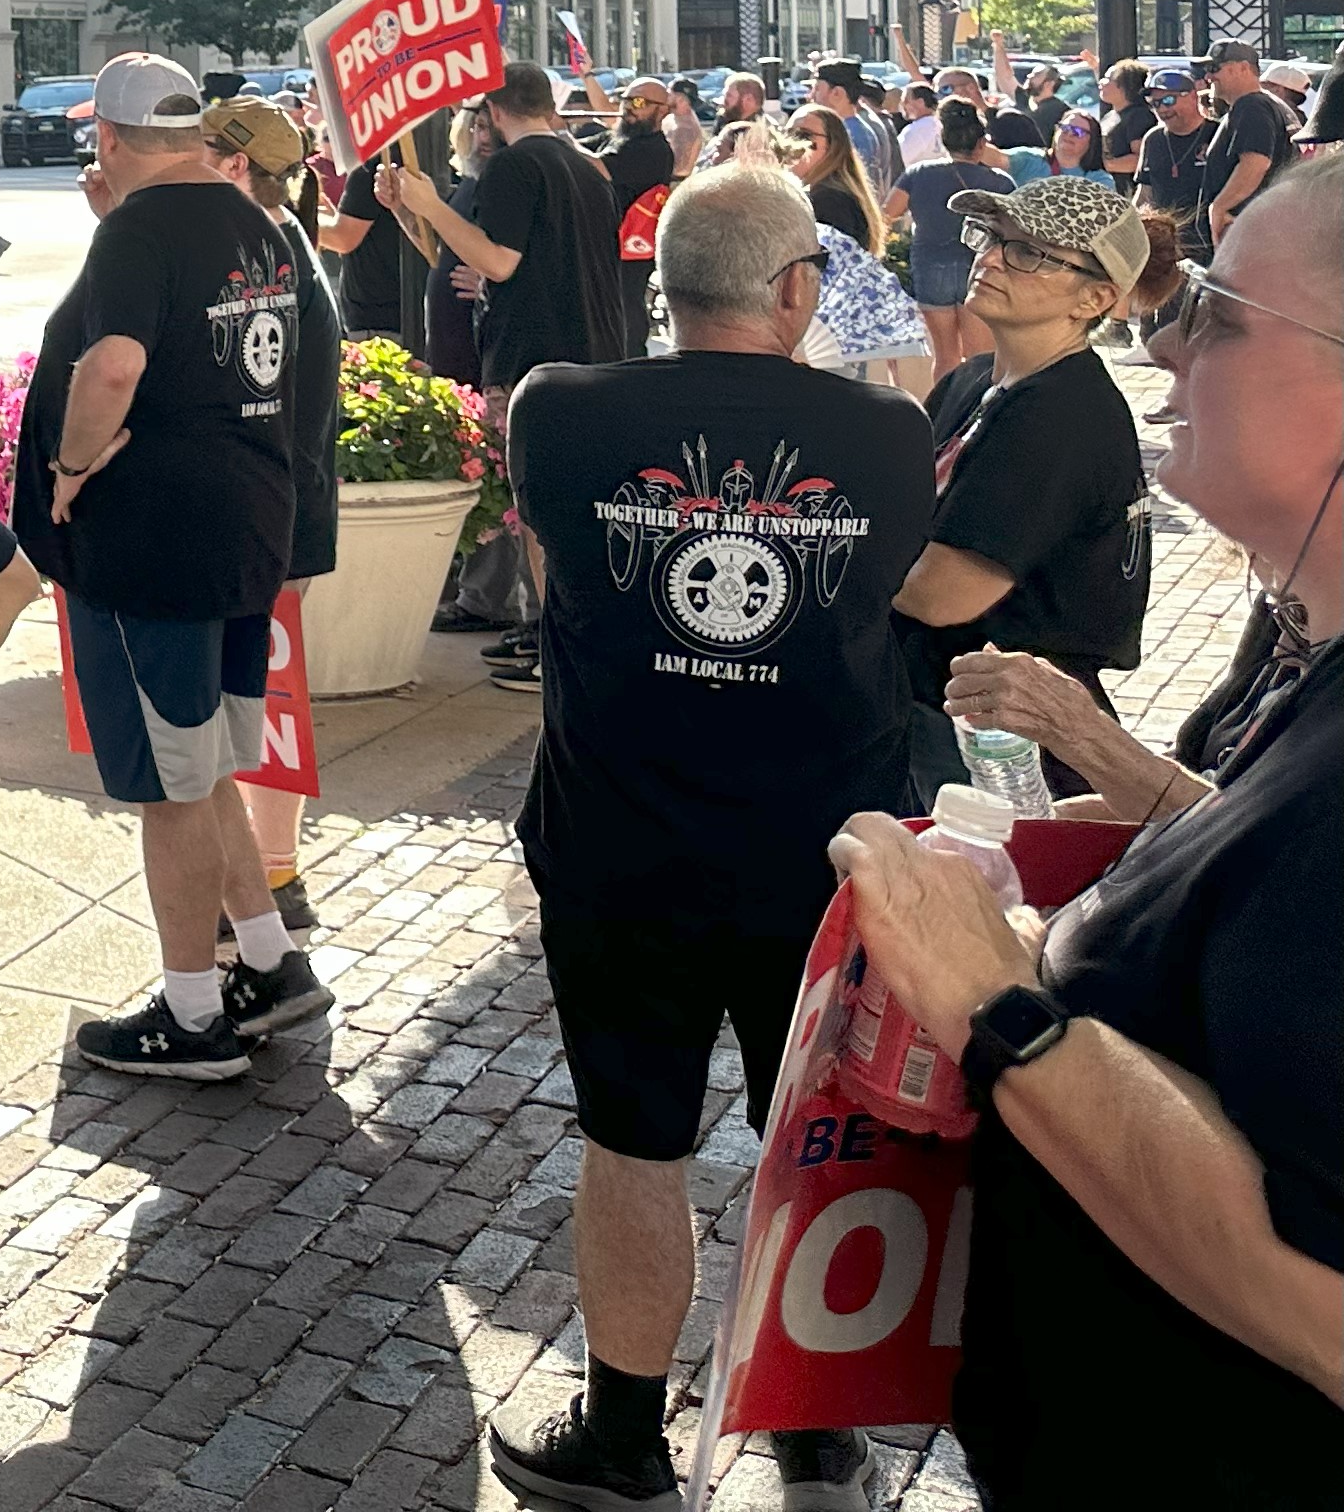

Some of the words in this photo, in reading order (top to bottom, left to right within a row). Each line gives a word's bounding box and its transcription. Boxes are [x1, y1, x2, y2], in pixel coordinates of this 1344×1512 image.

[376, 62, 391, 79] TO
[394, 46, 416, 66] BE
[350, 42, 490, 147] UNION
[594, 501, 679, 528] TOGETHER
[692, 512, 716, 530] WE
[720, 514, 753, 533] ARE
[758, 517, 869, 536] UNSTOPPABLE
[749, 597, 762, 609] M
[654, 653, 686, 674] IAM
[691, 658, 744, 681] LOCAL
[748, 664, 779, 683] 774
[797, 1113, 877, 1169] BE
